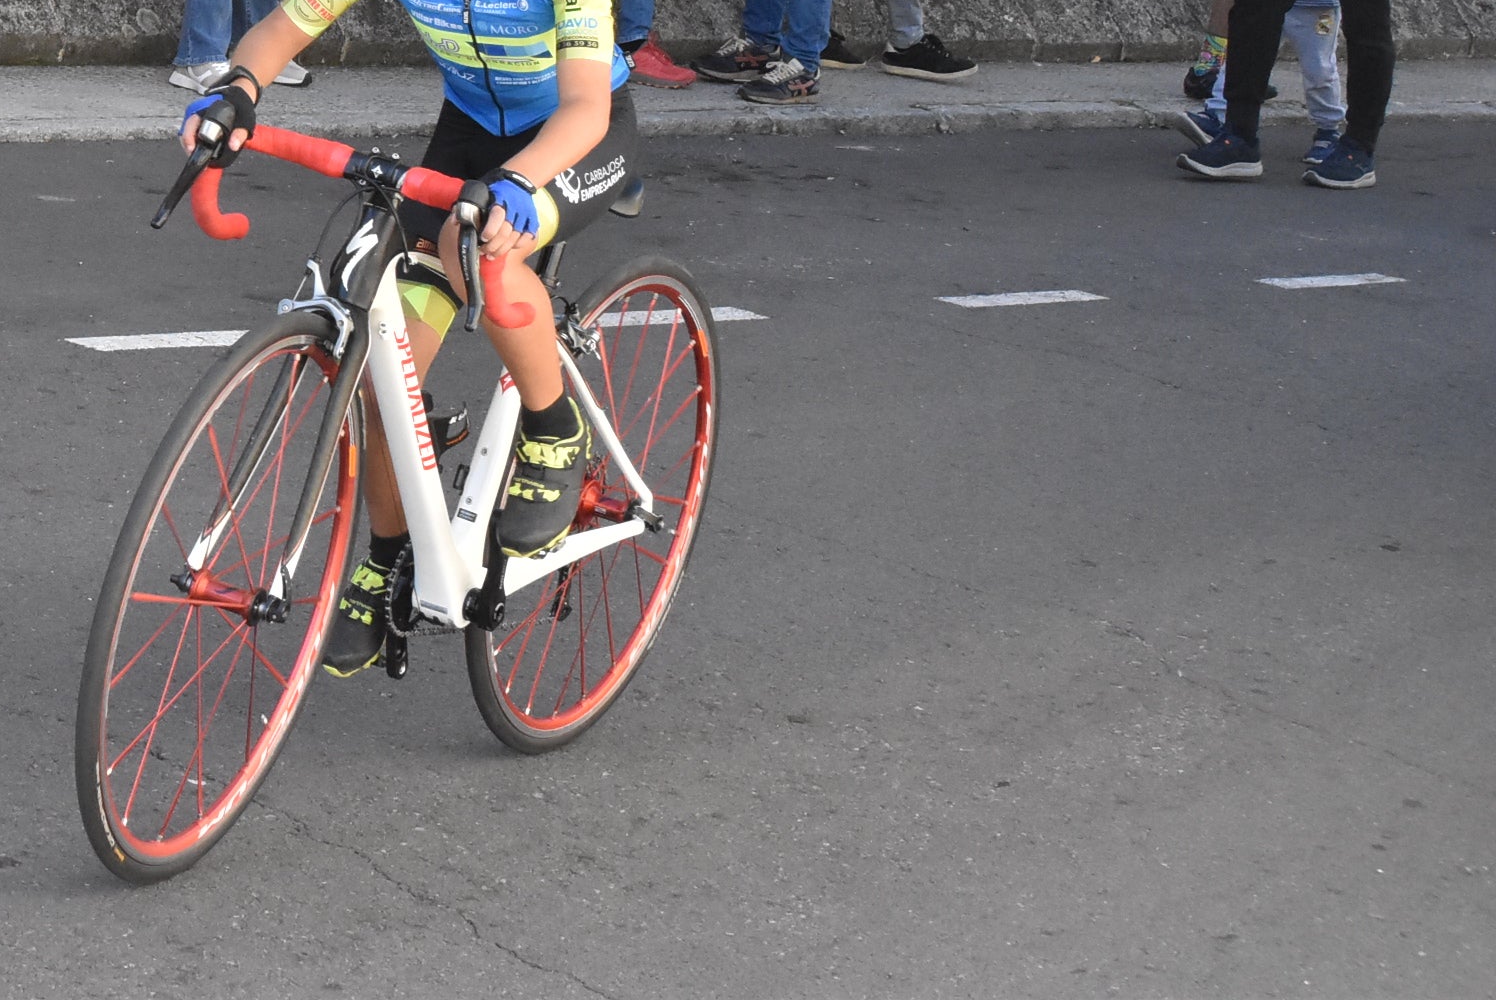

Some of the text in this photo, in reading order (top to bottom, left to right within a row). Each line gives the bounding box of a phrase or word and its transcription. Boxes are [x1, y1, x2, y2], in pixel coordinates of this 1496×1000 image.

[490, 23, 539, 36] MORO
[557, 17, 598, 30] DAVID
[584, 154, 625, 185] CARBAJOSA
[580, 166, 626, 202] EMPRESARIAL
